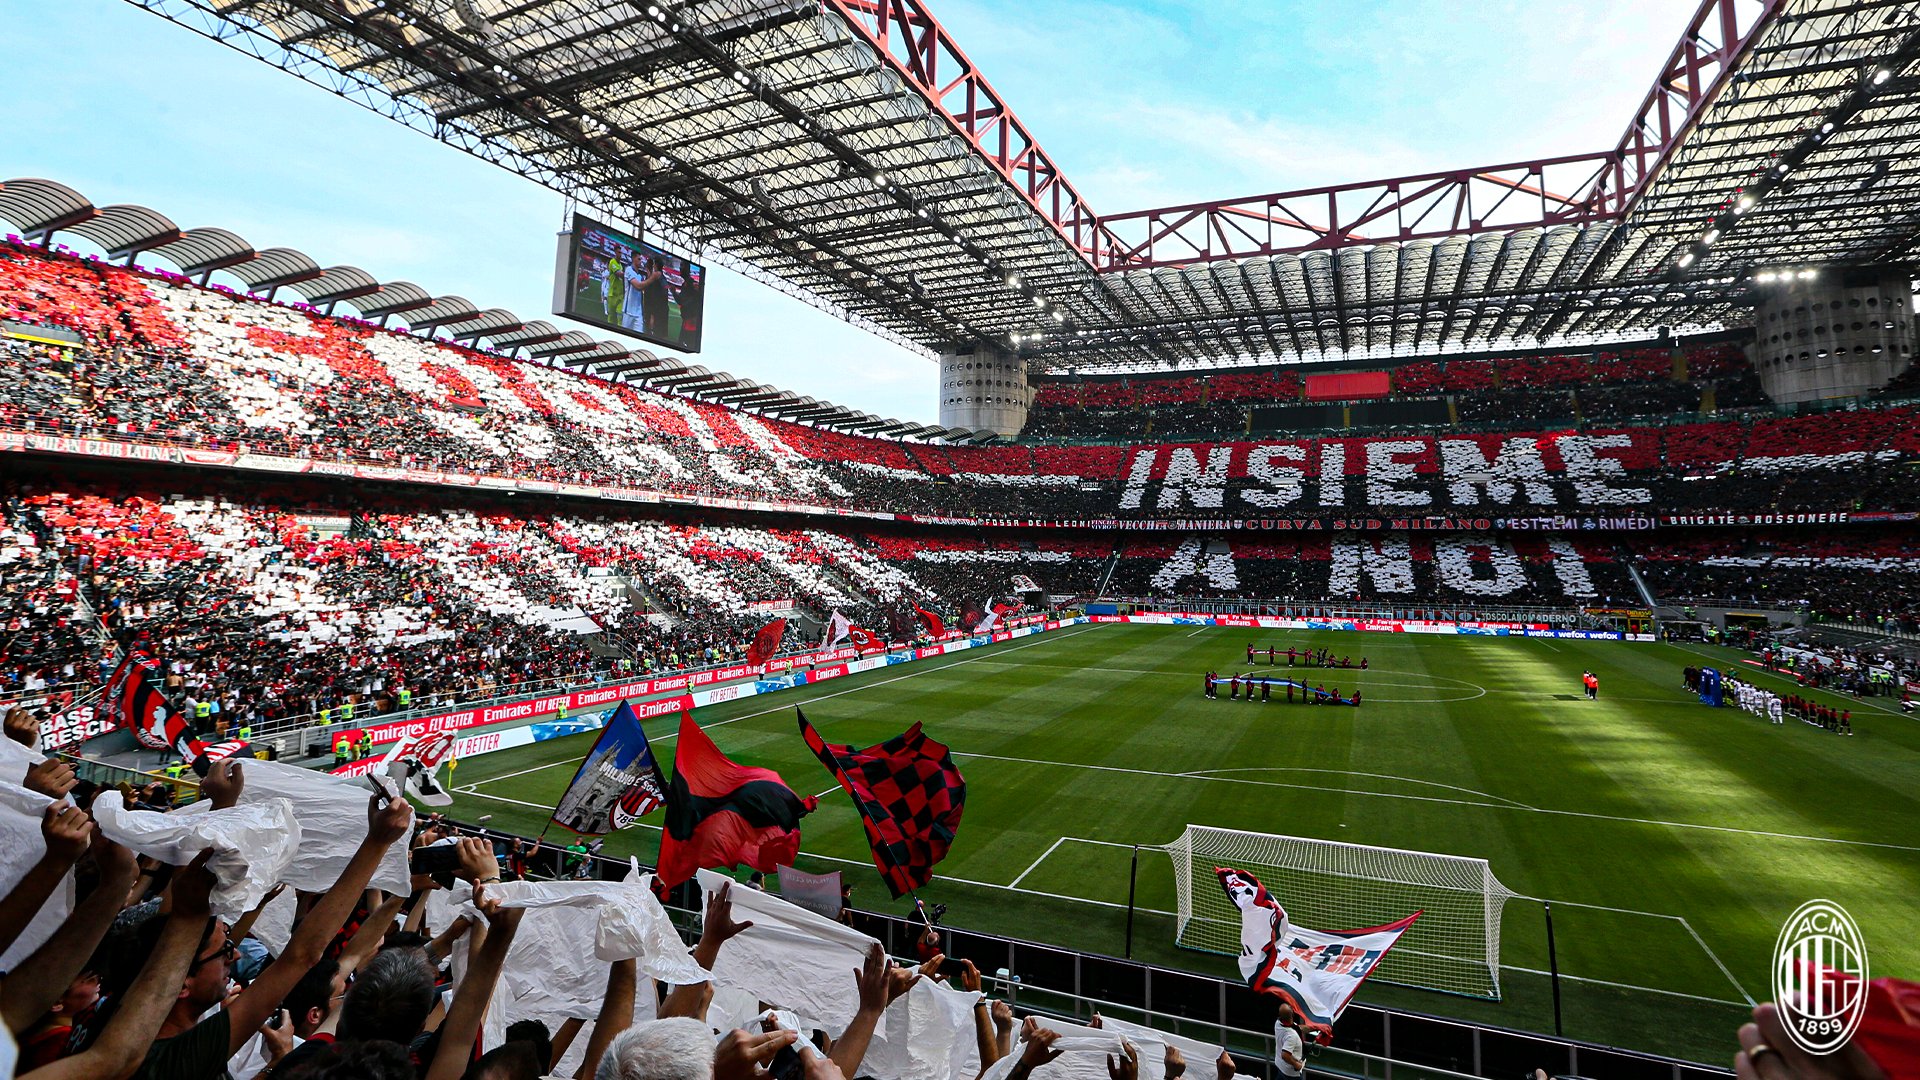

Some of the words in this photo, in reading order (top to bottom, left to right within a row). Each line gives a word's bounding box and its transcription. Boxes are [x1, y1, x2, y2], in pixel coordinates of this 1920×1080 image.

[36, 435, 81, 453] MILAN
[86, 440, 122, 458] CLUB
[127, 444, 170, 462] LATINA
[312, 463, 356, 476] KOSOVO
[1119, 433, 1651, 510] INSIEME
[986, 519, 1019, 527] FOSSA
[1028, 519, 1047, 527] DEI
[1056, 520, 1090, 528] LEONI
[1177, 519, 1232, 530] MANIERA
[1246, 519, 1323, 530] CURVA
[1334, 519, 1382, 530] SUD
[1391, 518, 1491, 530] MILANO
[1599, 517, 1655, 530] RIMEDI
[1670, 516, 1735, 526] BRIGATE
[1754, 512, 1848, 524] ROSSONERE
[1527, 629, 1555, 637] wefox
[1558, 631, 1586, 639] wefox
[1590, 631, 1618, 639] wefox
[654, 679, 686, 692] Emirates
[696, 671, 713, 683] BETTER
[717, 668, 745, 680] Emirates
[816, 667, 841, 681] Emirates
[578, 688, 617, 705] Emirates
[619, 686, 628, 698] FLY
[628, 683, 649, 696] BETTER
[709, 690, 719, 702] FLY
[719, 686, 739, 700] BETTER
[484, 700, 532, 722] Emirates
[535, 699, 547, 713] FLY
[639, 699, 681, 718] Emirates
[428, 716, 445, 733] FLY
[445, 711, 475, 728] BETTER
[465, 733, 500, 755] BETTER
[600, 761, 635, 786] MILANO
